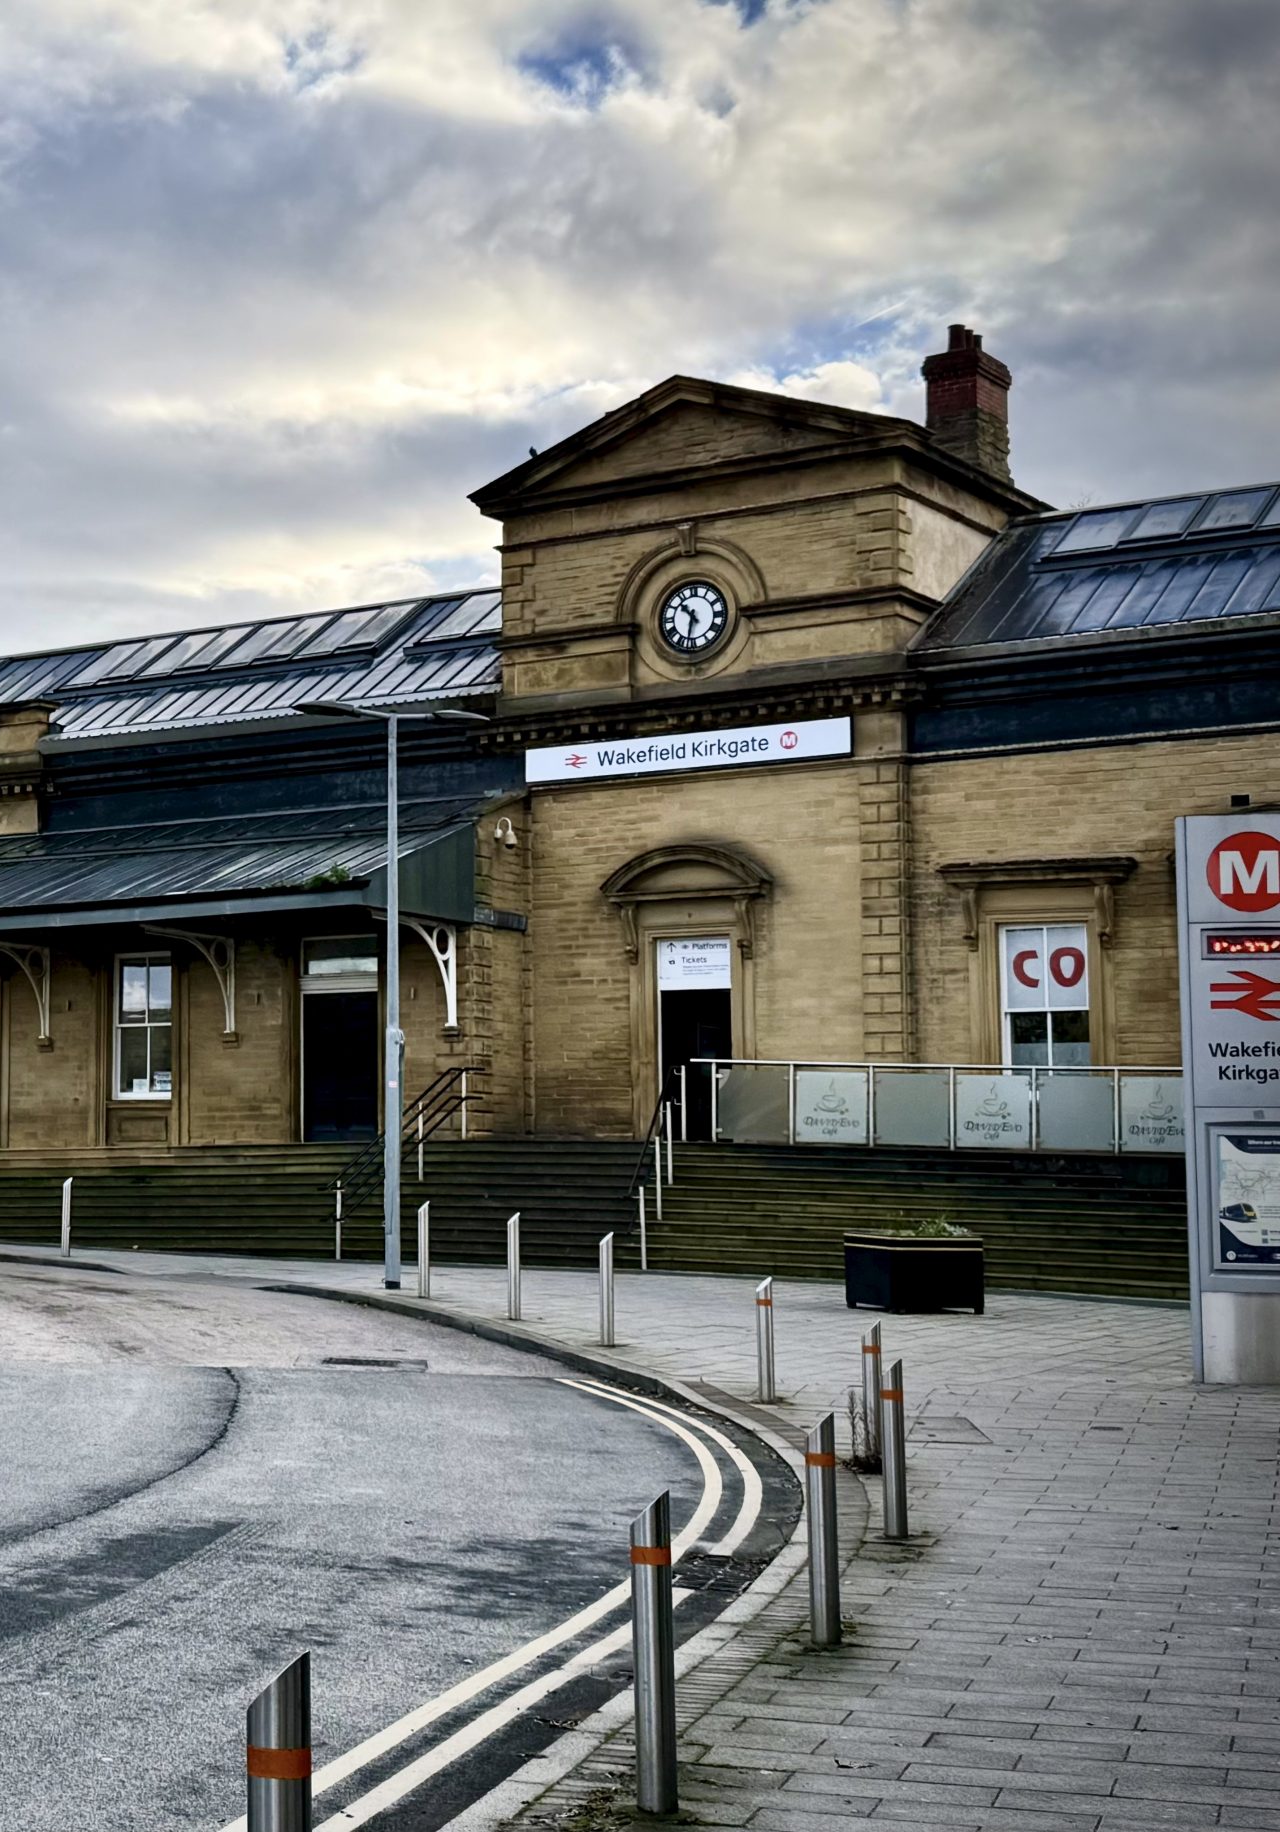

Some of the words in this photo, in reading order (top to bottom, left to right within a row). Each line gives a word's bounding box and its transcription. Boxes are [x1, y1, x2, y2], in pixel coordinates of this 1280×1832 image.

[598, 743, 685, 766] Wakefield
[692, 737, 769, 758] Kirkgate
[1219, 850, 1280, 894] M
[692, 942, 728, 950] Platforms
[682, 956, 707, 964] Tickets
[1012, 946, 1086, 988] CO
[1208, 1041, 1280, 1058] Wakefi
[1218, 1064, 1280, 1084] Kirkga
